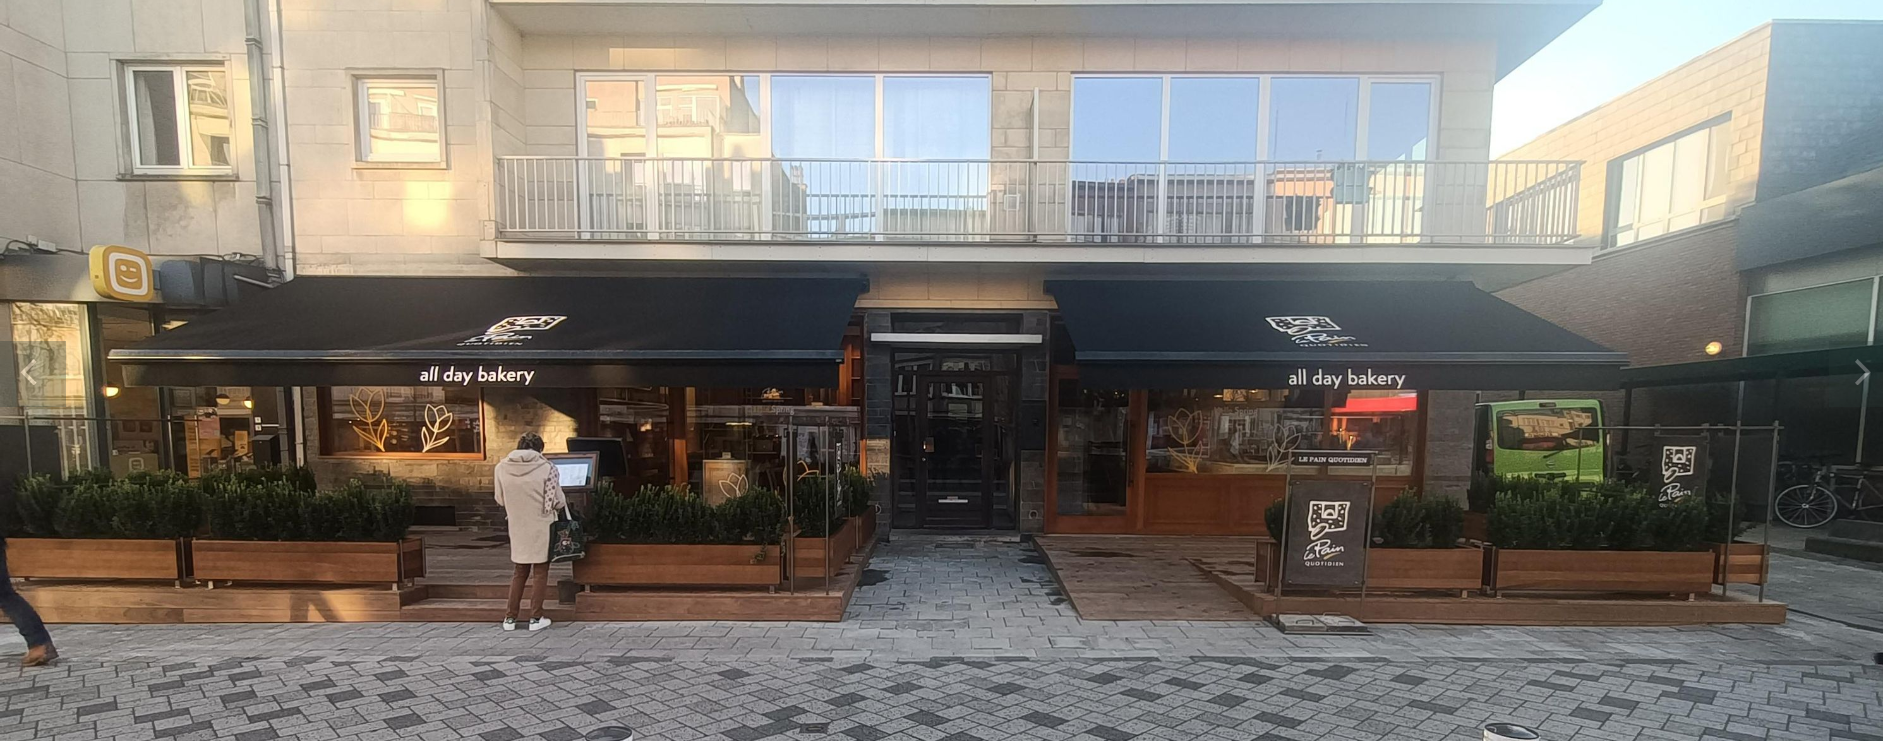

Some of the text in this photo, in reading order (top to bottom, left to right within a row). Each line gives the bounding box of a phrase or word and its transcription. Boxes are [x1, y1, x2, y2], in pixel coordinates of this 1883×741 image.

[1294, 332, 1356, 343] Pain
[419, 366, 535, 386] all day bakery
[1288, 368, 1406, 389] all day bakery
[1328, 456, 1368, 464] QUOTIDIEN
[1661, 483, 1691, 500] Pain
[1307, 540, 1345, 557] Pain
